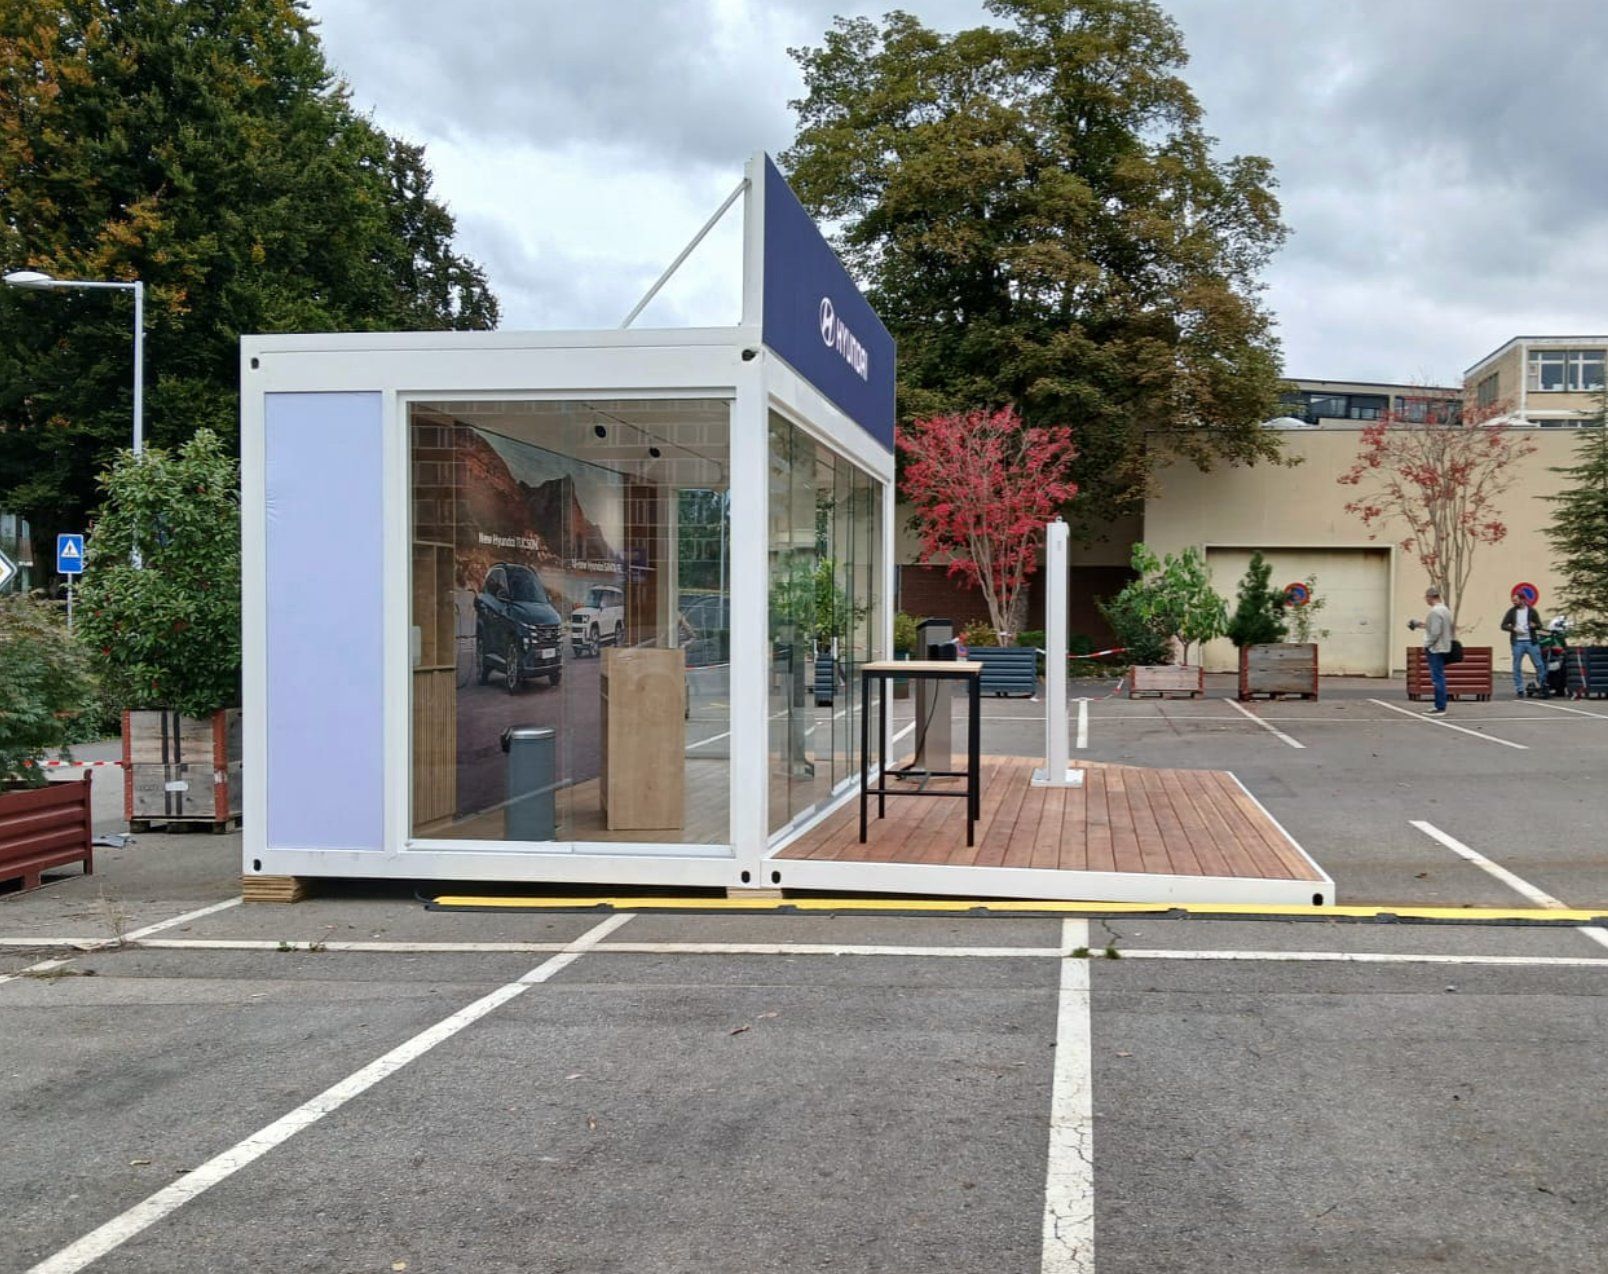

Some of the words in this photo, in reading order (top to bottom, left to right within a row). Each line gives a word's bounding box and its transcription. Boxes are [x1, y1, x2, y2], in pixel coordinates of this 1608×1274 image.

[836, 317, 868, 382] HYUNDAI
[478, 532, 492, 544] New
[492, 533, 516, 548] Hyundai
